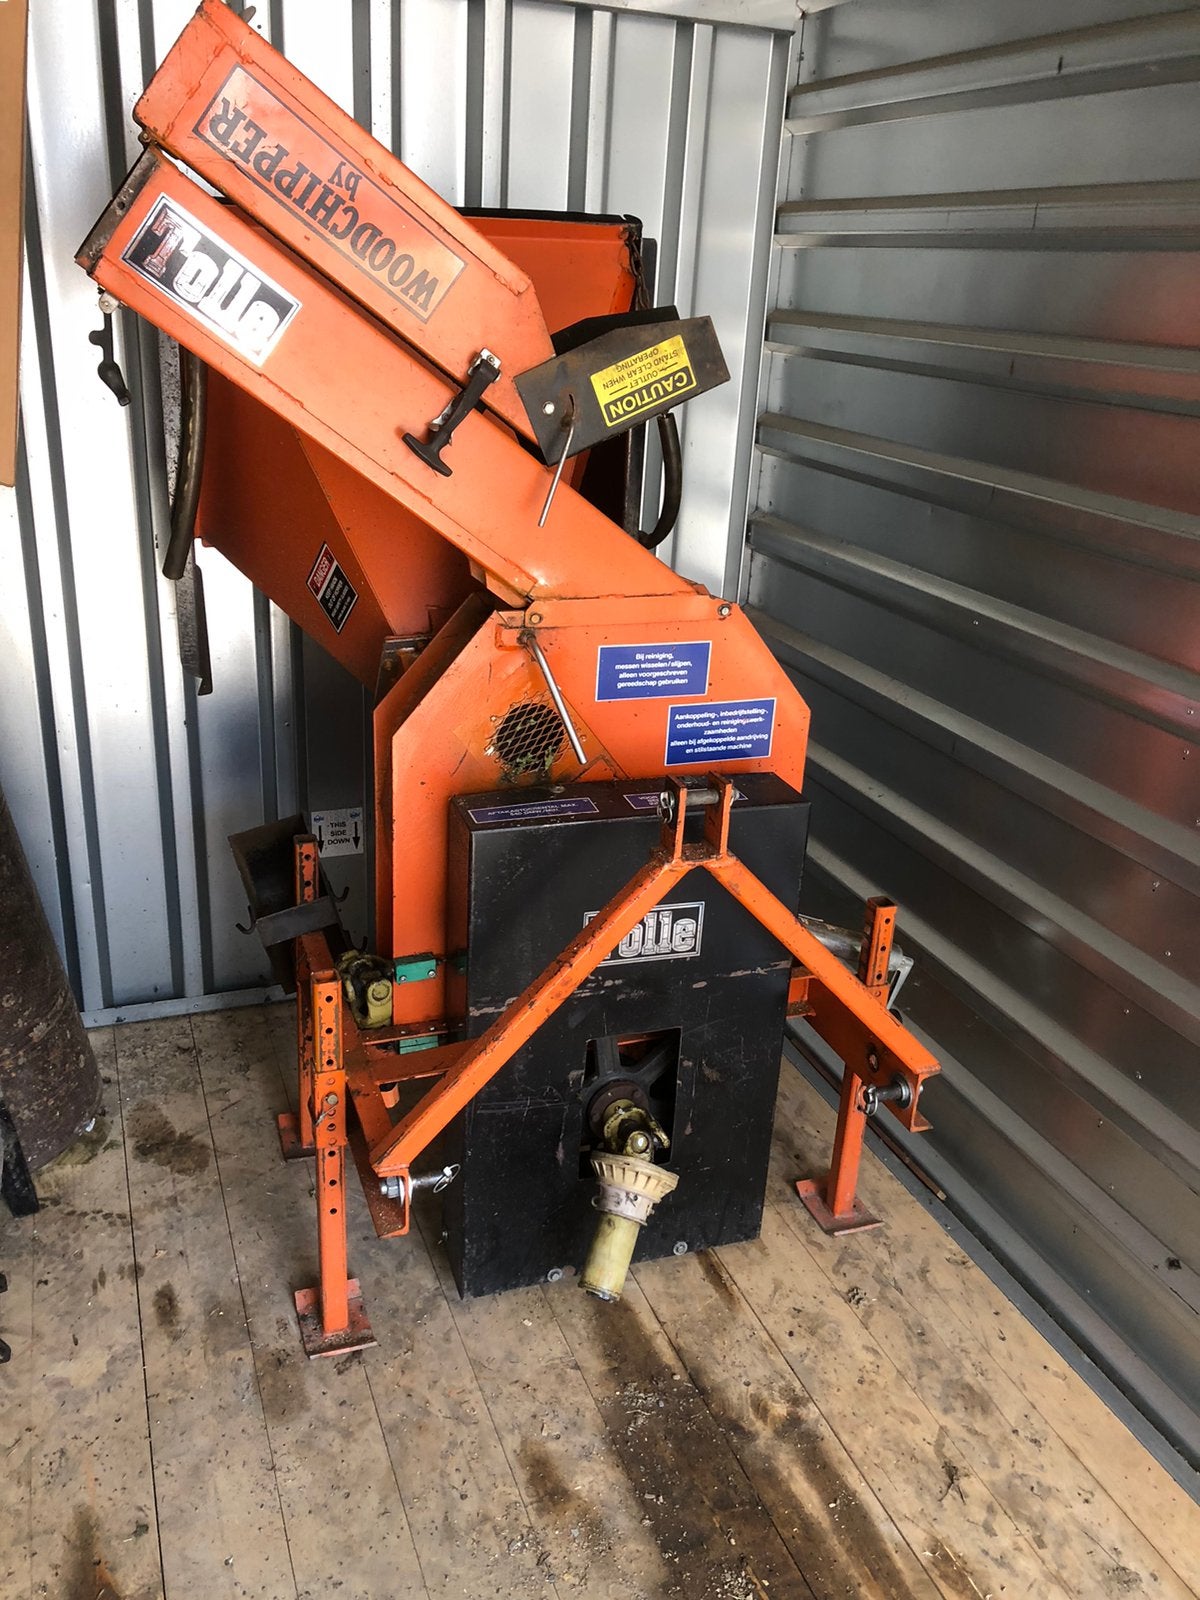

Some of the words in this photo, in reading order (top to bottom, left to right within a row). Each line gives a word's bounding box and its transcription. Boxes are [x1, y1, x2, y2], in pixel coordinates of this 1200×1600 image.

[328, 160, 362, 202] by
[209, 97, 440, 313] WOODCHIPPER
[616, 348, 659, 372] OPERATING
[654, 349, 678, 366] STAND
[627, 361, 652, 379] CLEAR
[602, 373, 626, 390] WHEN
[629, 370, 658, 388] OUTLET
[609, 371, 688, 419] CAUTION
[313, 556, 330, 588] DANGER
[635, 653, 645, 661] Bij
[645, 652, 675, 661] reiniging,
[638, 669, 688, 678] voorgeschreven
[616, 680, 657, 689] gereedschap
[657, 678, 688, 687] gebruiken
[670, 739, 688, 747] alleen
[696, 735, 736, 746] afgekoppelde
[736, 733, 769, 742] aandrijving
[703, 727, 738, 736] zaamheden
[727, 742, 752, 750] machine
